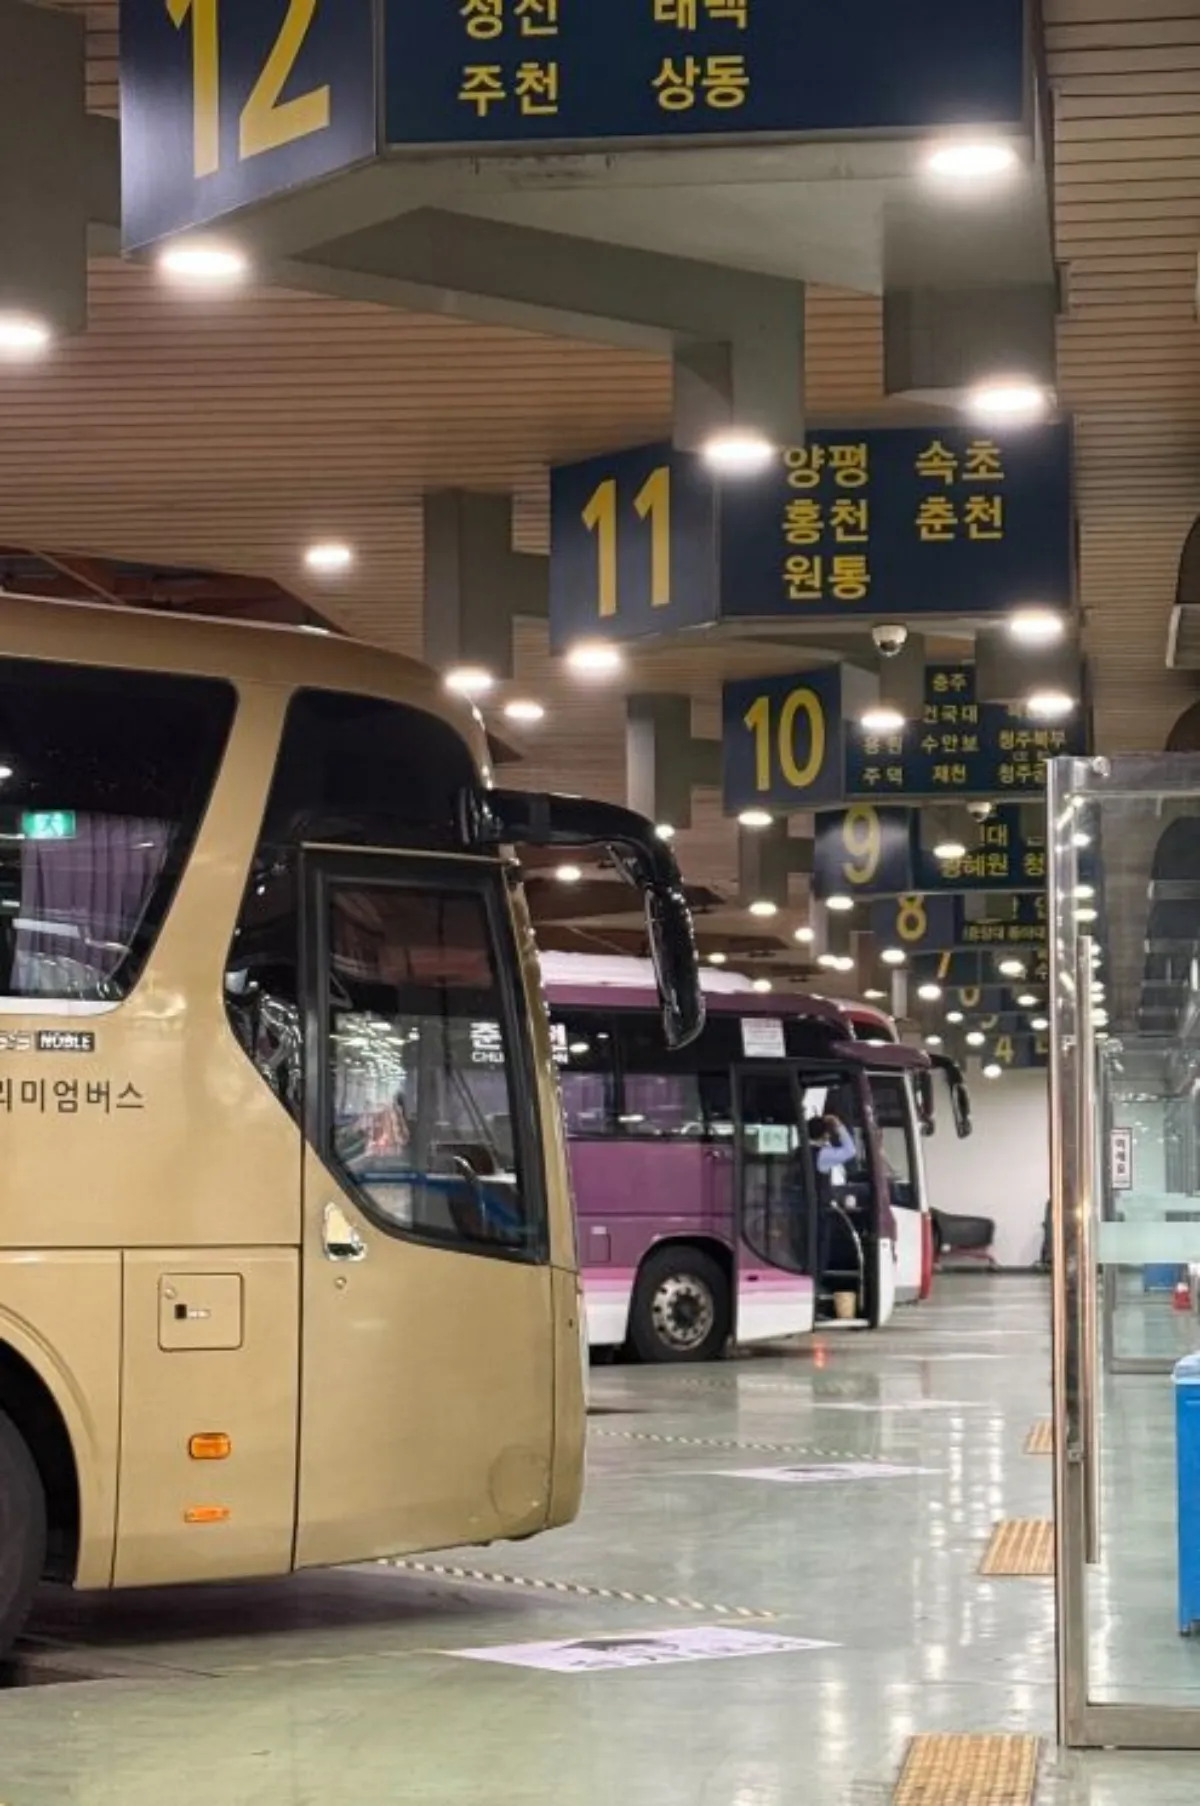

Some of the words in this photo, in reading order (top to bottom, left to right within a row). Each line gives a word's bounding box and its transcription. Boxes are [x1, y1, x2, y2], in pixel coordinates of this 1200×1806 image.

[166, 0, 330, 179] 12
[458, 62, 558, 117] 주천
[652, 55, 750, 110] 상동
[782, 443, 869, 489] 양평
[915, 441, 1005, 485] 속초
[581, 465, 670, 617] 11
[782, 497, 869, 545] 홍천
[915, 495, 1004, 541] 춘천
[782, 554, 871, 599] 원통
[743, 688, 825, 791] 10
[842, 803, 881, 884] 9
[896, 893, 927, 941] 8
